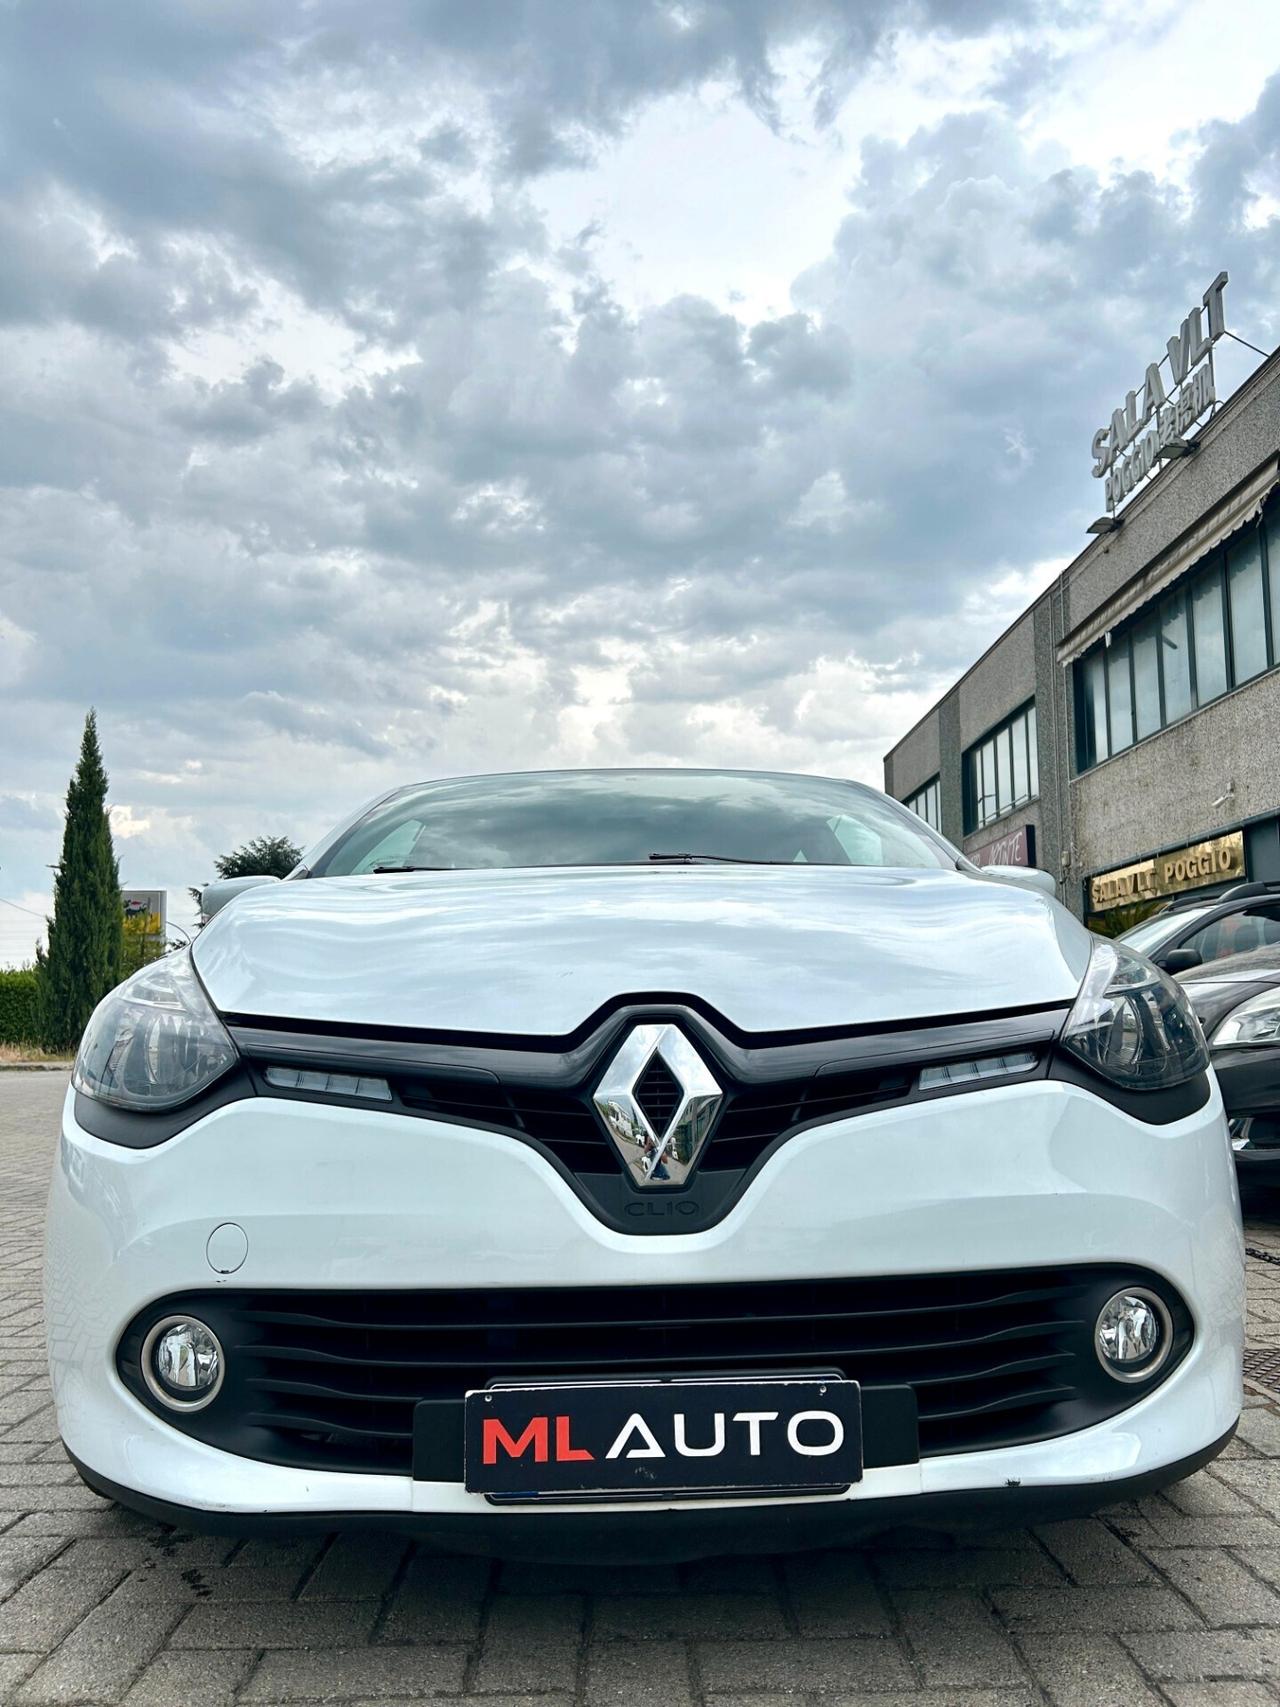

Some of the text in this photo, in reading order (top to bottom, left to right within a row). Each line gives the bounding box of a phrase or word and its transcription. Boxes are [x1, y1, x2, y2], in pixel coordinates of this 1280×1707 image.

[1105, 430, 1160, 512] POGGIO
[1164, 849, 1231, 884] POGGIO
[624, 1200, 700, 1217] CLIO
[482, 1410, 845, 1465] ML AUTO
